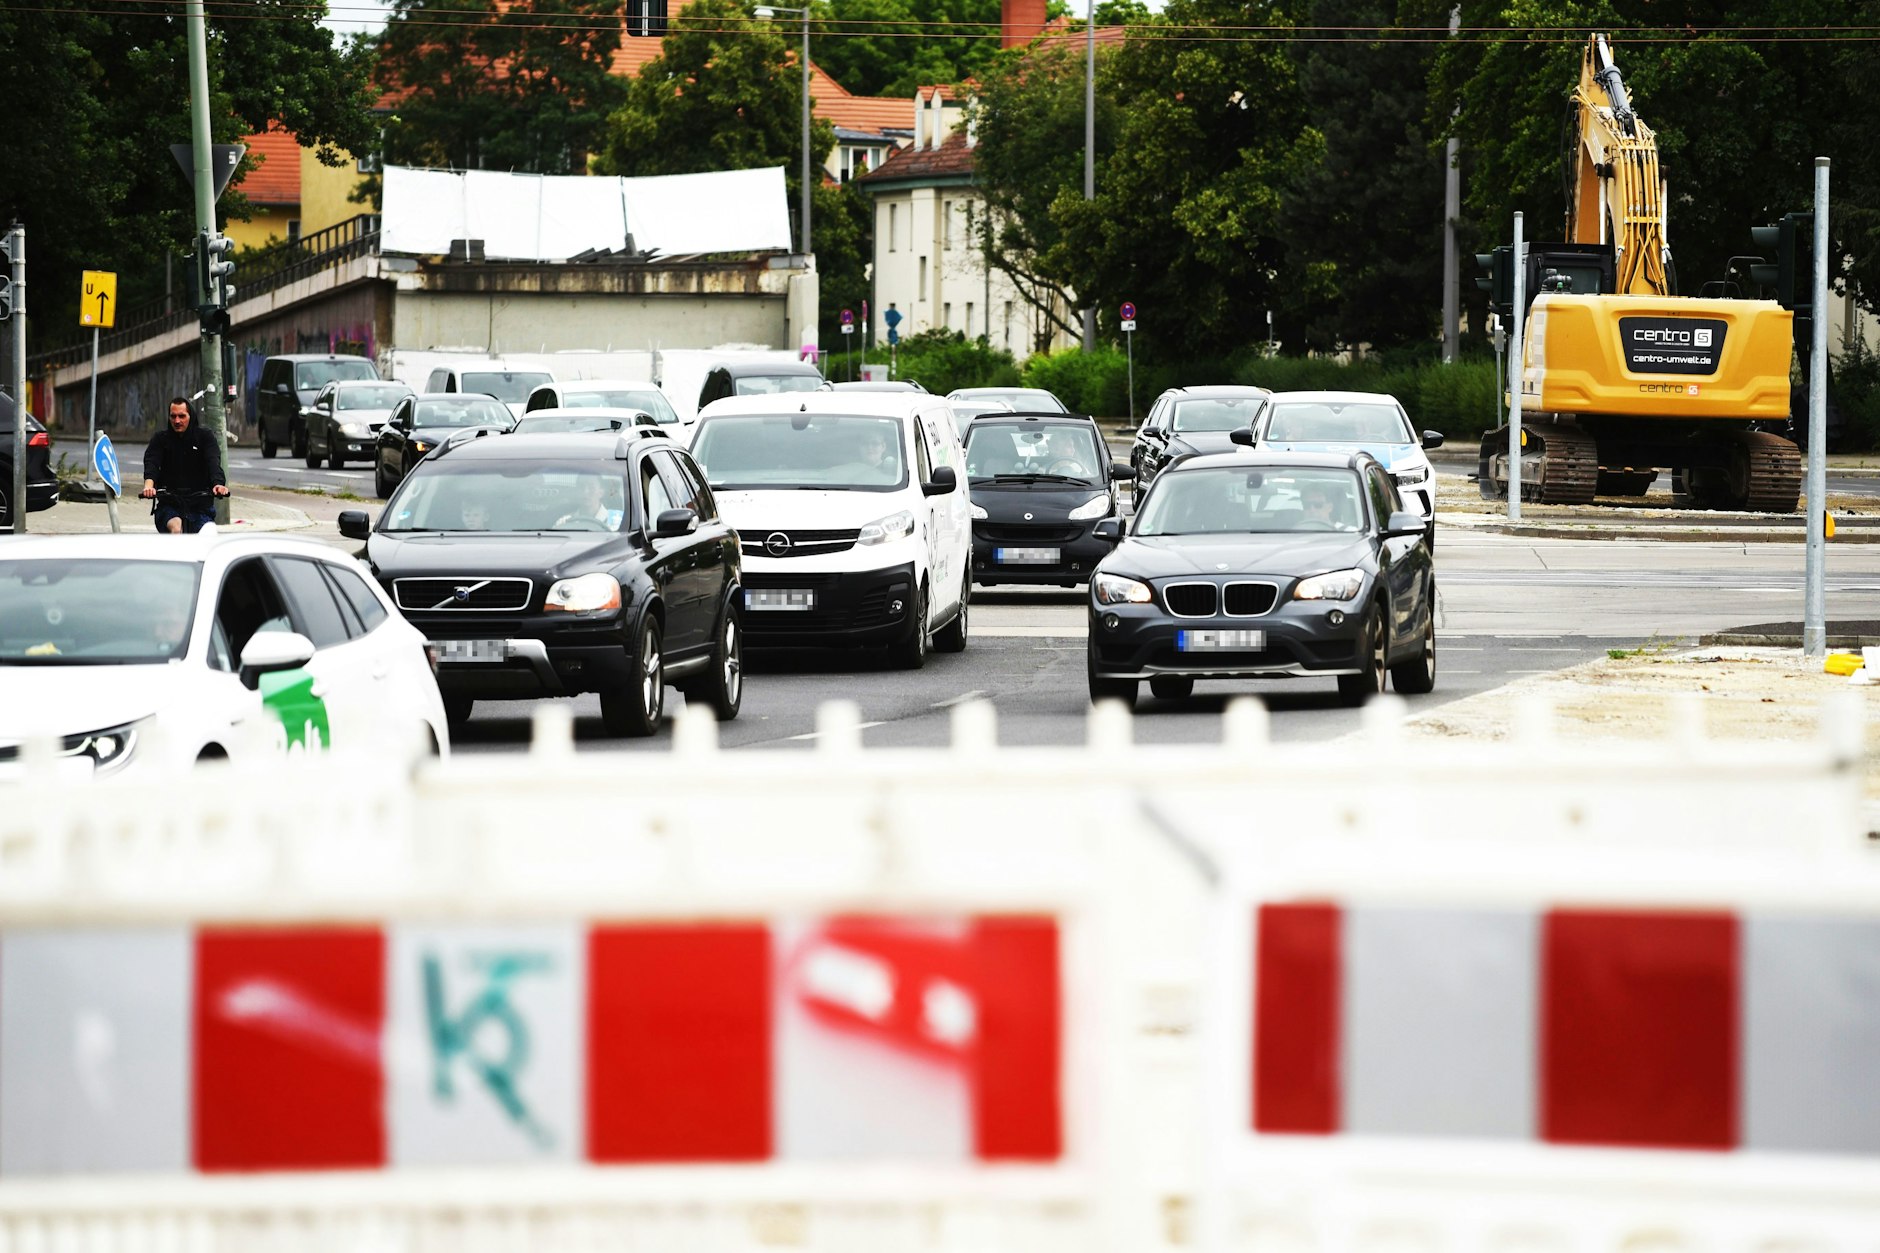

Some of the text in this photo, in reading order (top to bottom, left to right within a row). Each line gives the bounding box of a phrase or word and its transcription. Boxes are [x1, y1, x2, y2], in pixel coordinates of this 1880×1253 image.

[86, 283, 94, 295] U
[1633, 328, 1691, 342] centro
[1633, 354, 1712, 365] centro-umwelt.de
[1639, 383, 1683, 394] centro
